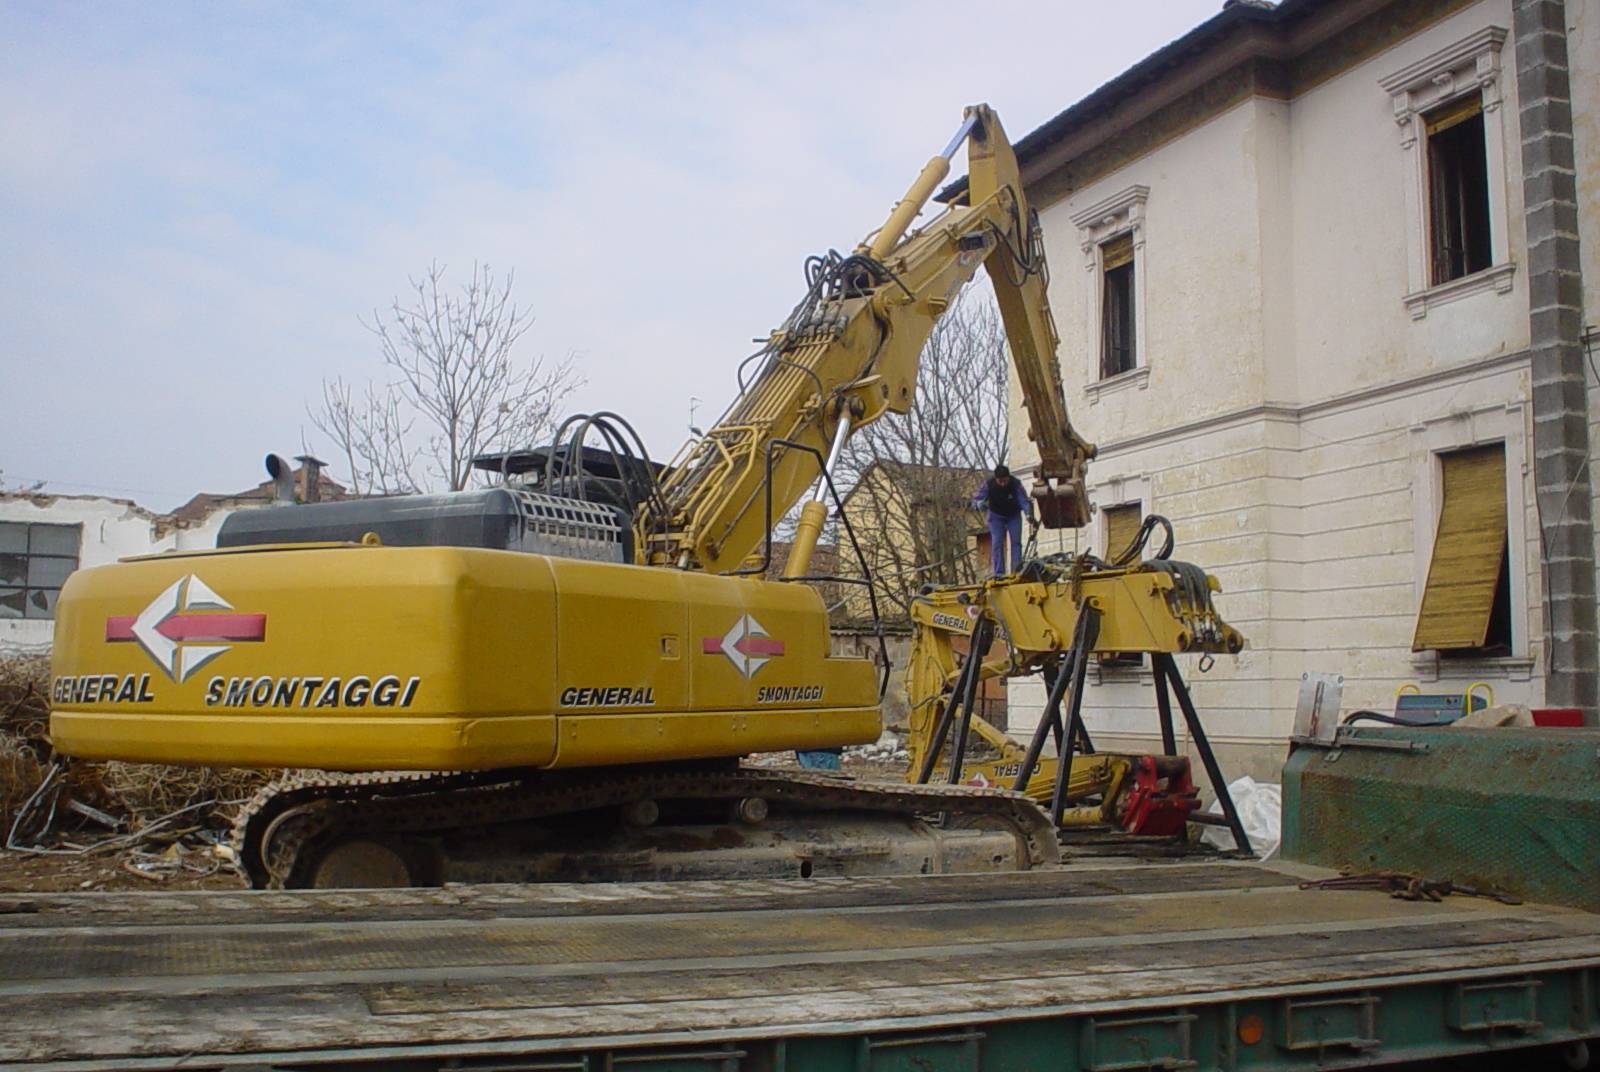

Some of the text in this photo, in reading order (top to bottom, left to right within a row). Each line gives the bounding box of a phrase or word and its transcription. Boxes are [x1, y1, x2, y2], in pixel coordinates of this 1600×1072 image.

[932, 612, 969, 631] GENERAL
[53, 673, 421, 708] GENERAL SMONTAGGI
[559, 685, 824, 708] GENERAL SMONTAGGI
